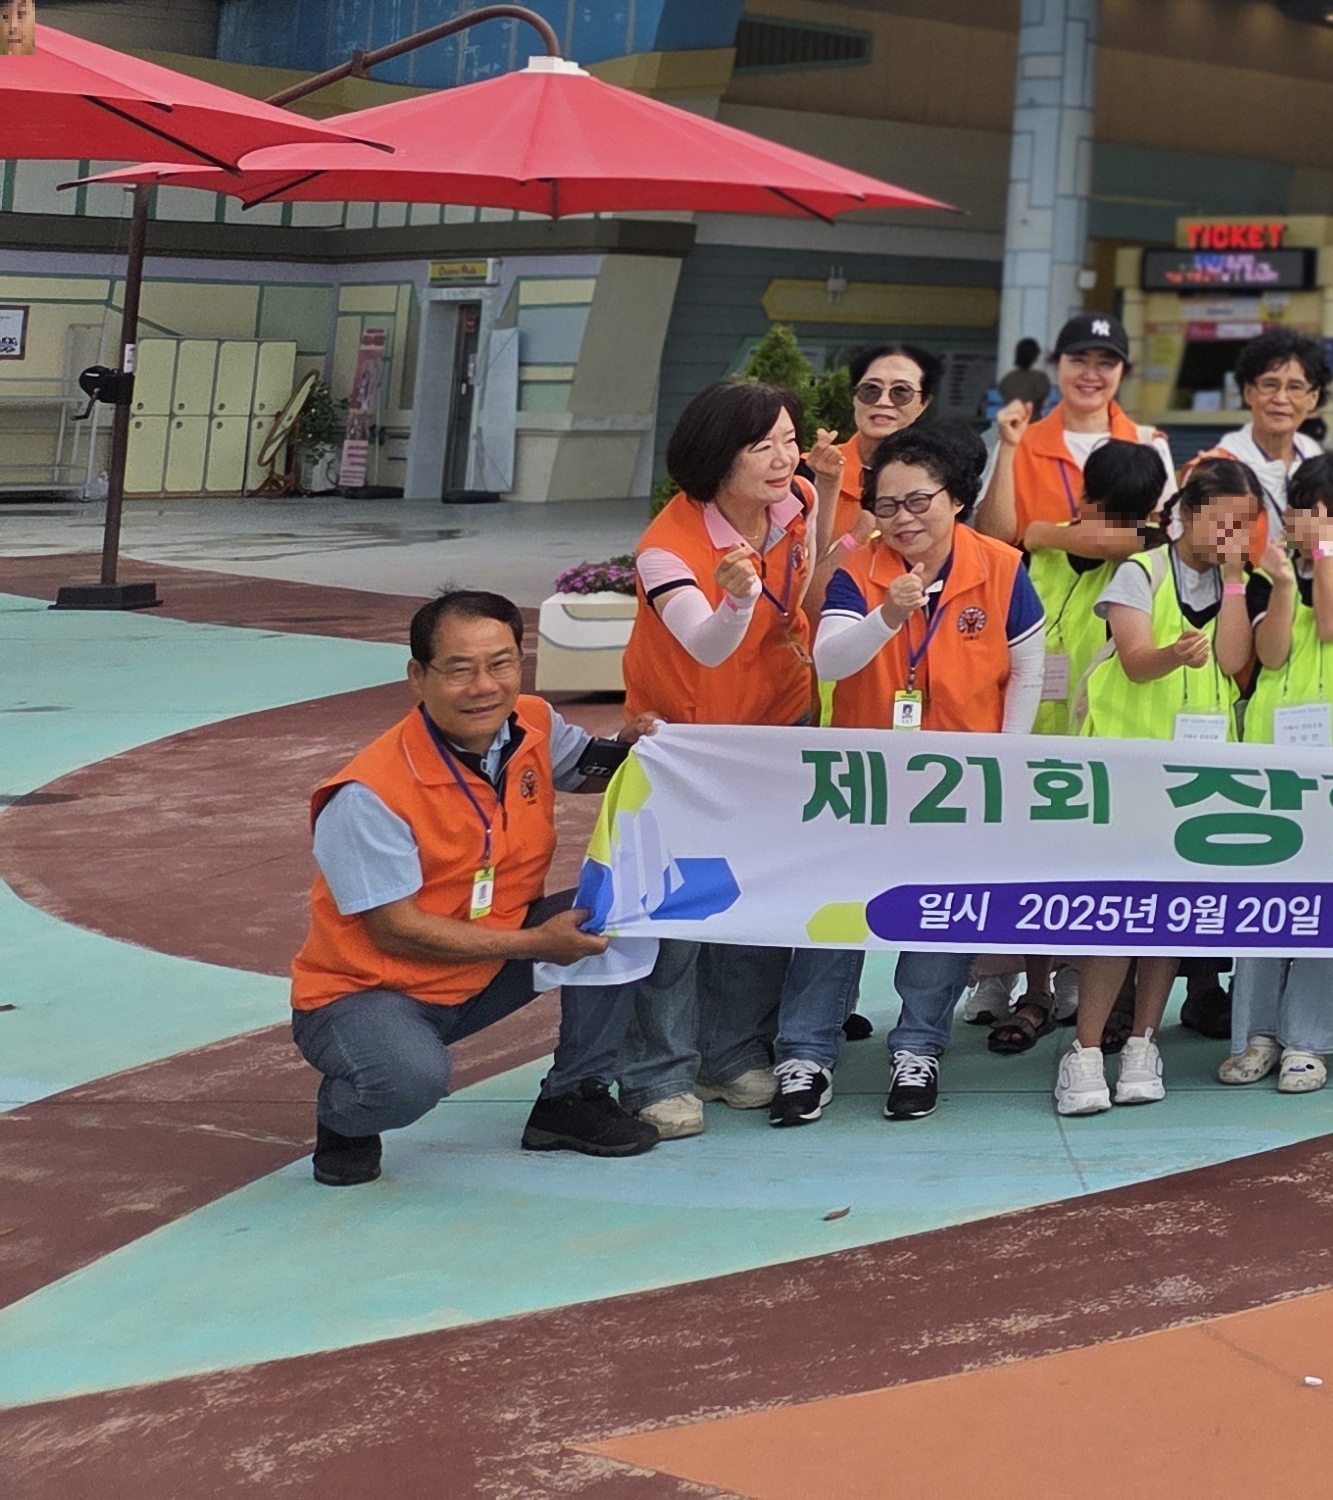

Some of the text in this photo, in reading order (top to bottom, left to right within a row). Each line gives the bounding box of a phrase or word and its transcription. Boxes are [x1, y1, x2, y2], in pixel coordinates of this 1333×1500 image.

[1186, 222, 1285, 248] TICKET
[802, 750, 1110, 825] 제21회
[918, 891, 991, 932] 일시
[1015, 893, 1158, 933] 2025년
[1166, 894, 1228, 935] 9월
[1235, 894, 1322, 936] 20일
